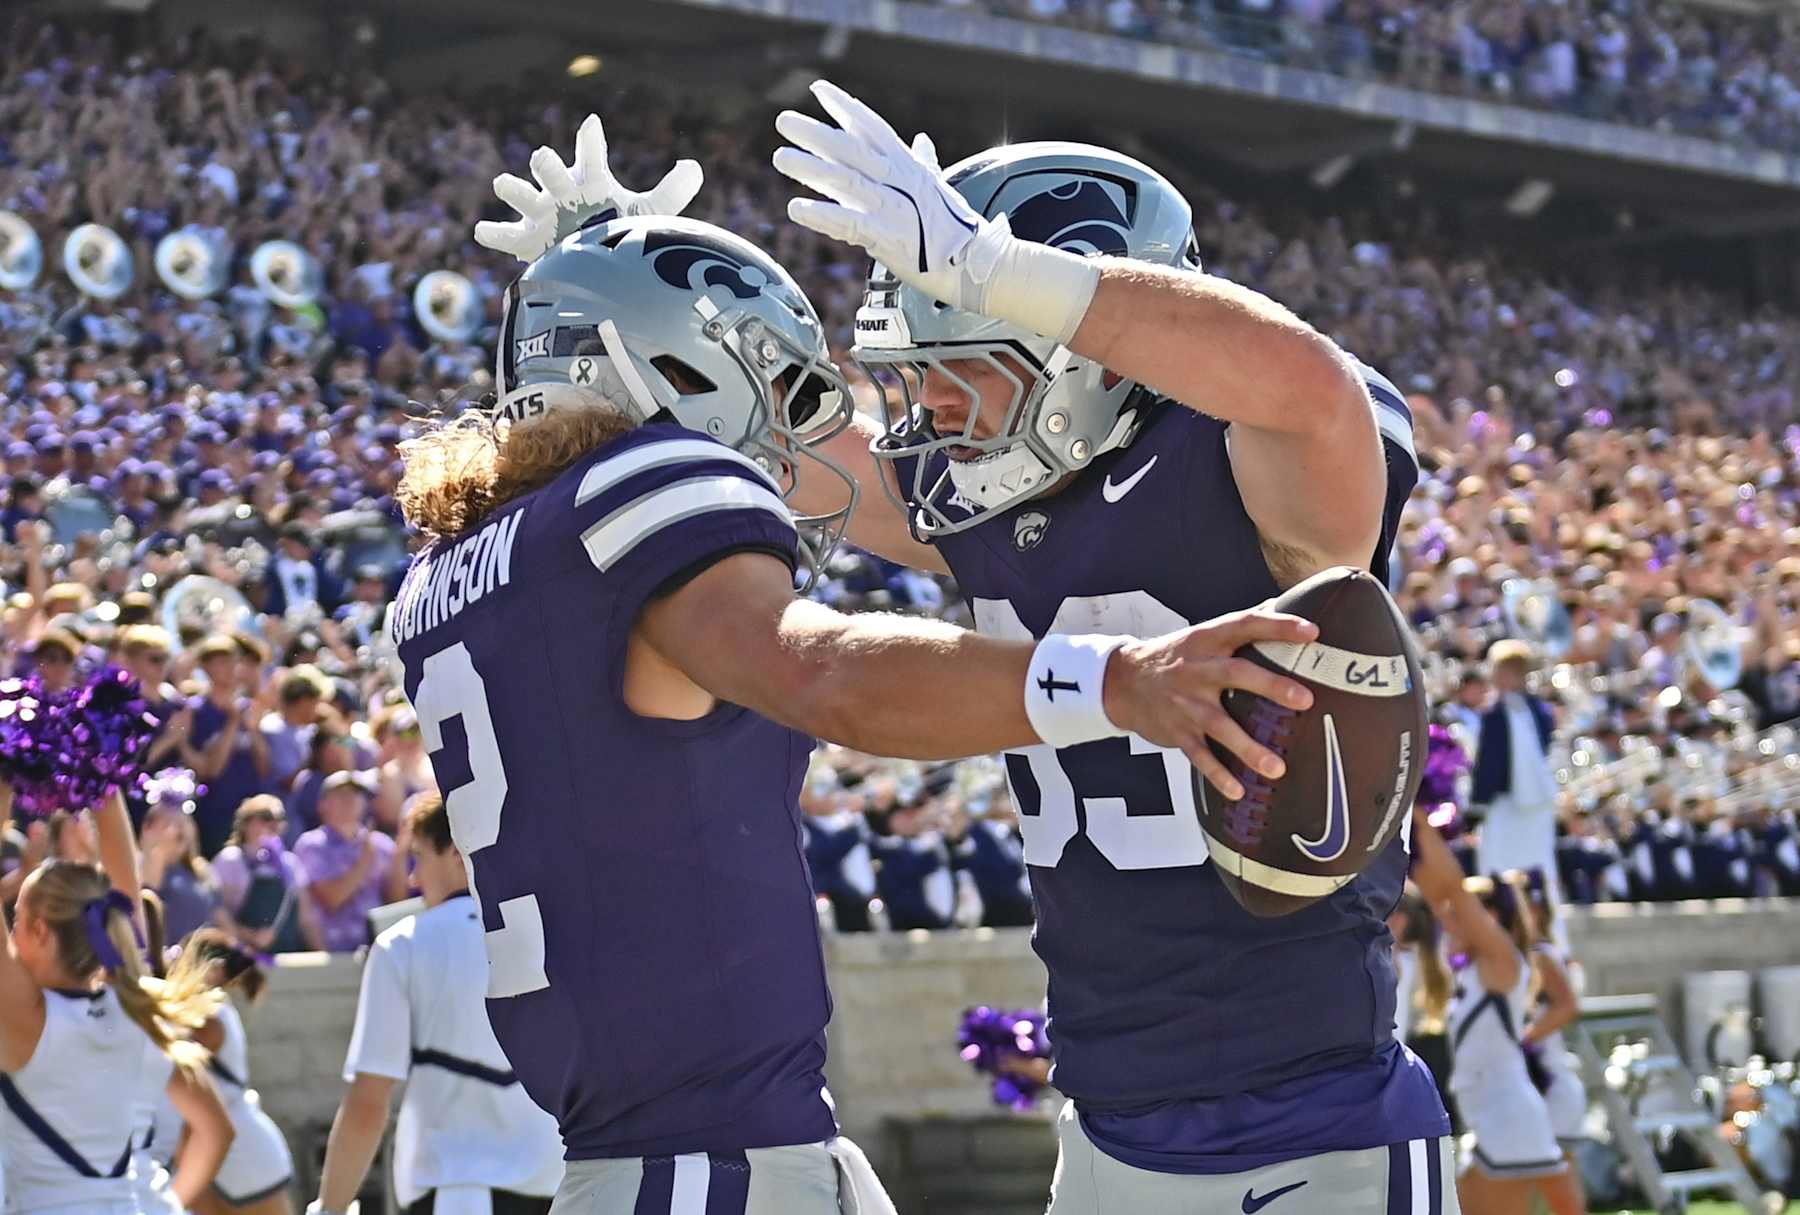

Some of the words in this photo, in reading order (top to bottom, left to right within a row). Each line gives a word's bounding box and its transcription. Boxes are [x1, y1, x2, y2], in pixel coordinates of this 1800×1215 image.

[516, 331, 549, 365] XII
[393, 507, 524, 645] JOHNSON
[414, 641, 551, 999] 2
